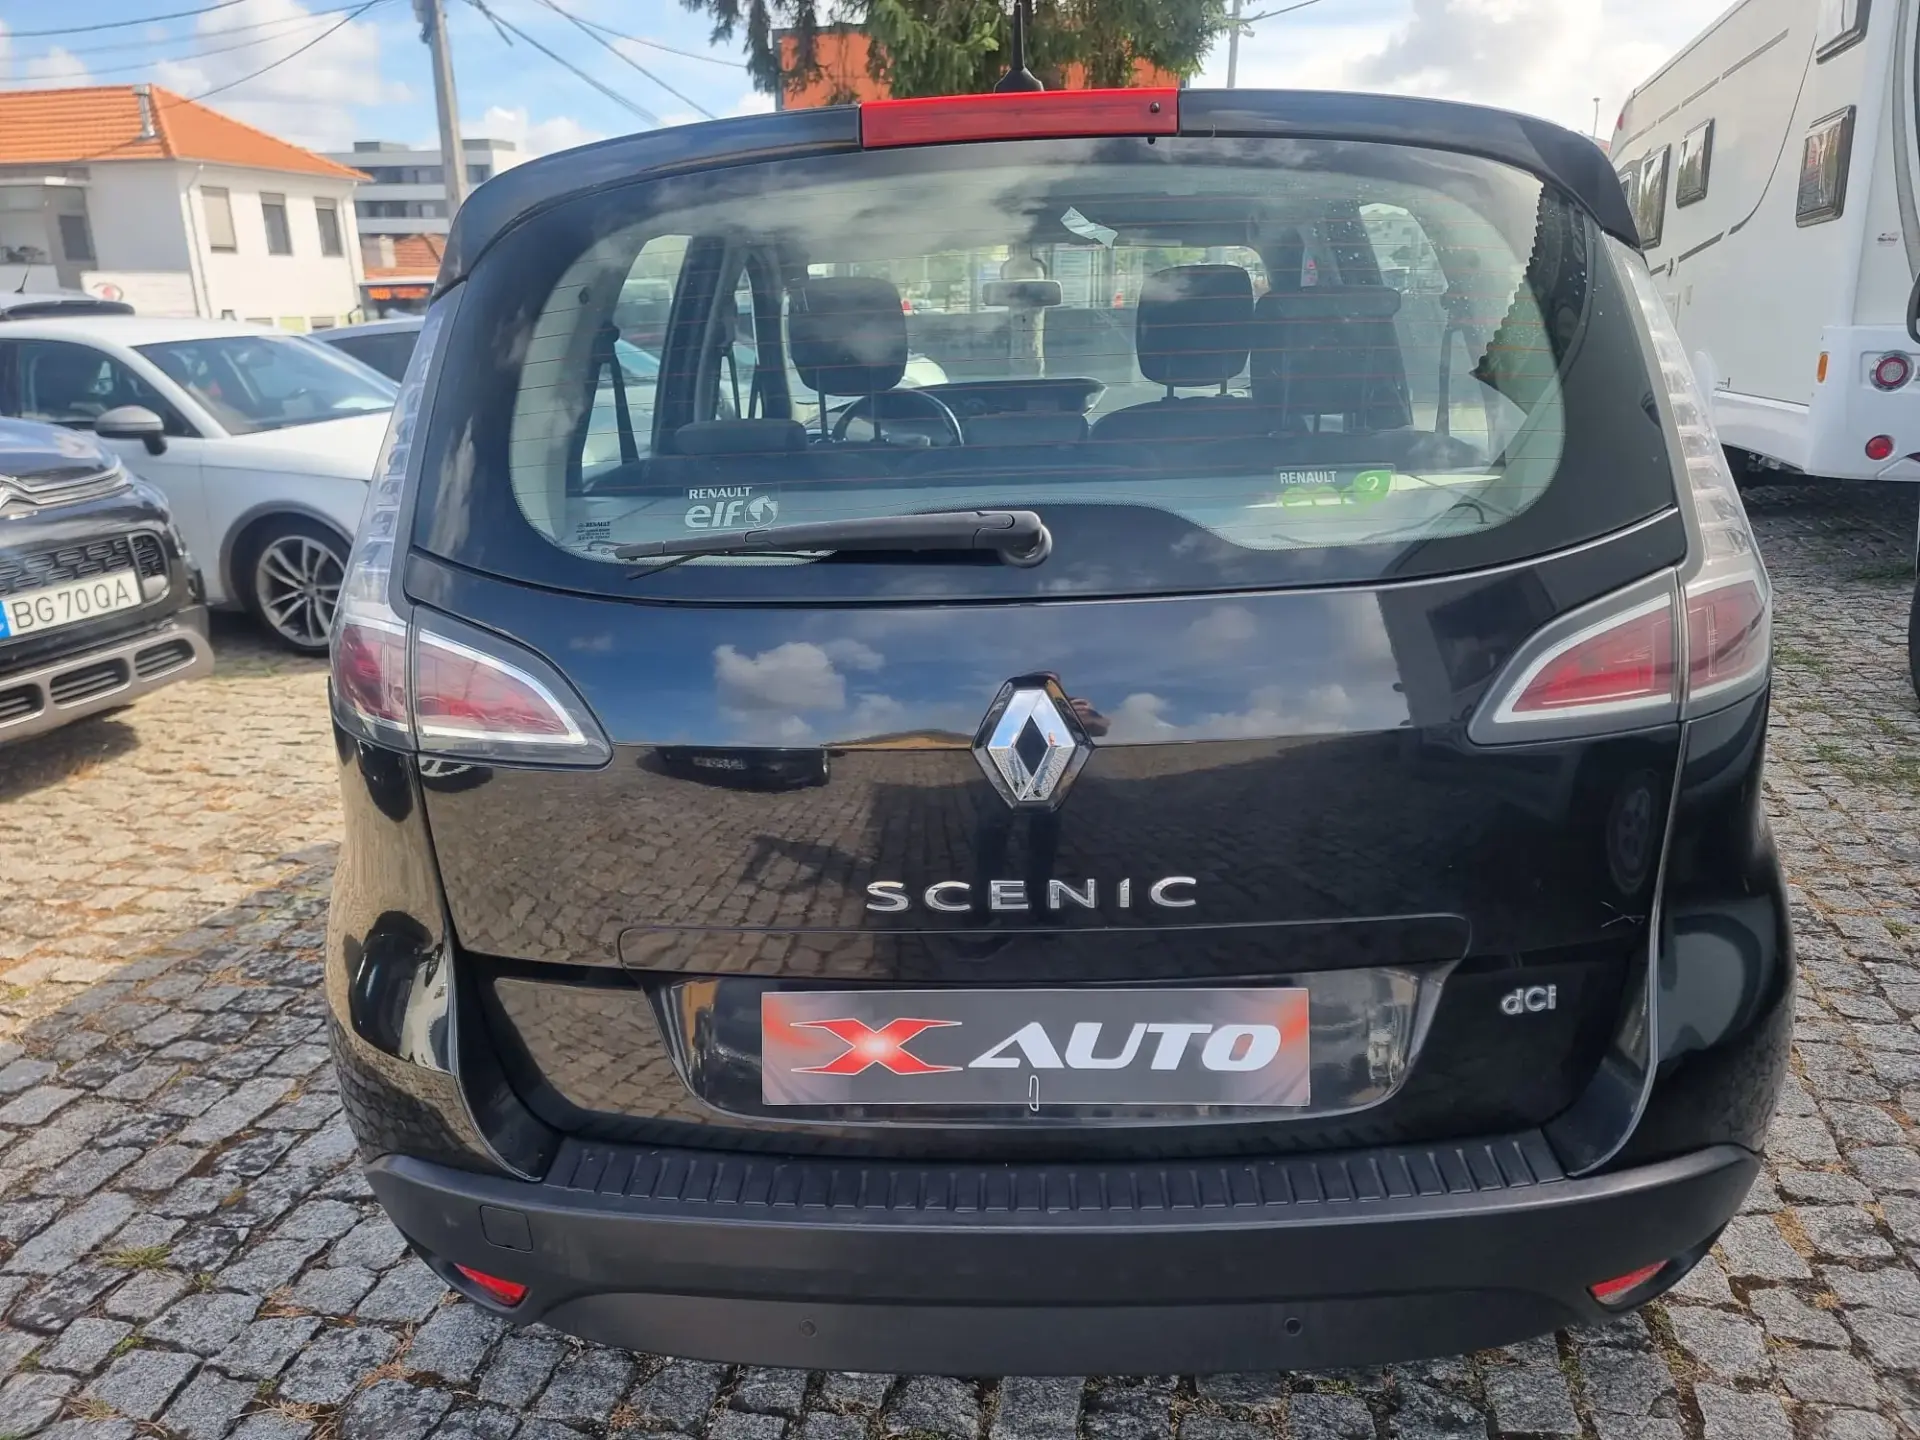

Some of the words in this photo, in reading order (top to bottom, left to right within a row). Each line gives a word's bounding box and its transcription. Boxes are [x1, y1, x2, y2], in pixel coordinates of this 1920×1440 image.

[1280, 471, 1337, 484] RENAULT
[689, 486, 753, 499] RENAULT
[684, 500, 744, 528] elf
[866, 876, 1197, 912] SCENIC
[1501, 984, 1557, 1015] dCi
[790, 1017, 963, 1075] X
[967, 1021, 1282, 1072] AUTO
